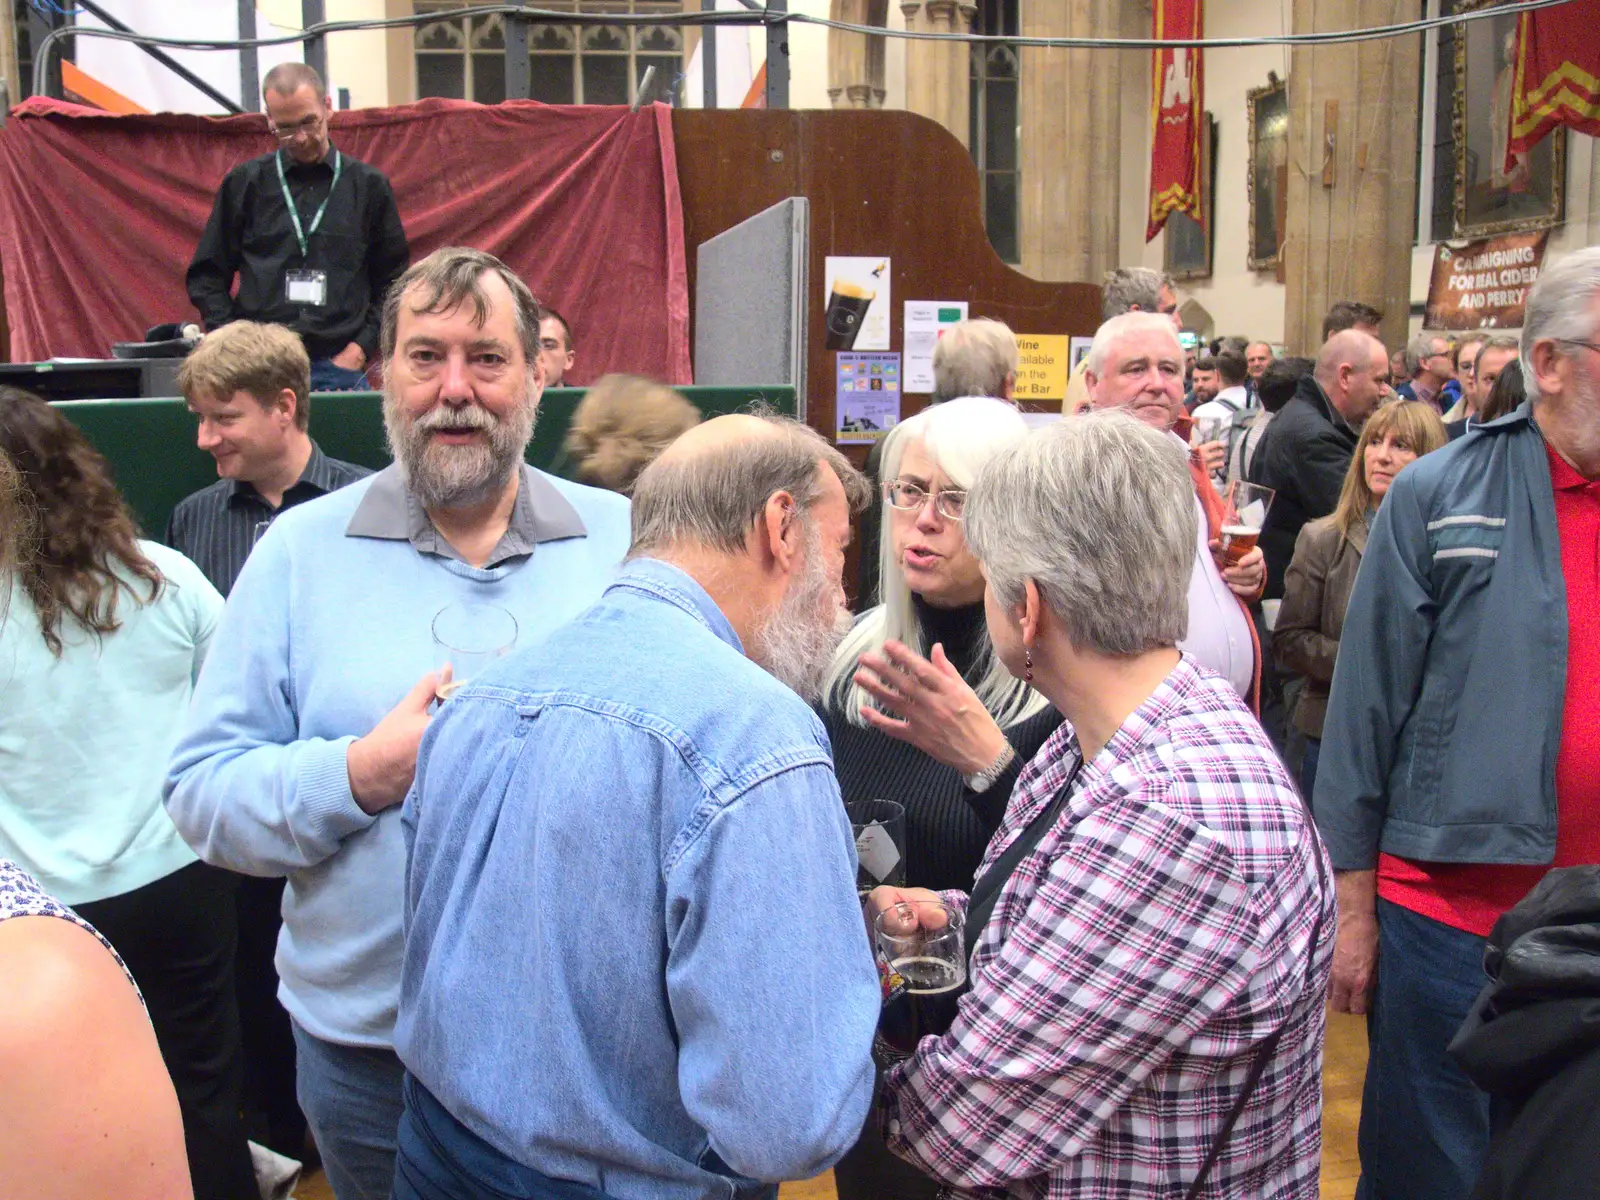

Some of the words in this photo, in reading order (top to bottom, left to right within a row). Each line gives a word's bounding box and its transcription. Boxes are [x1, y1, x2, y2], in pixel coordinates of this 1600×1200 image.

[1448, 275, 1474, 290] FOR
[1500, 267, 1537, 285] CIDER
[1459, 294, 1484, 309] AND
[1487, 289, 1525, 306] PERRY
[1020, 354, 1054, 364] ailable
[1030, 369, 1046, 378] the
[1031, 384, 1050, 393] Bar
